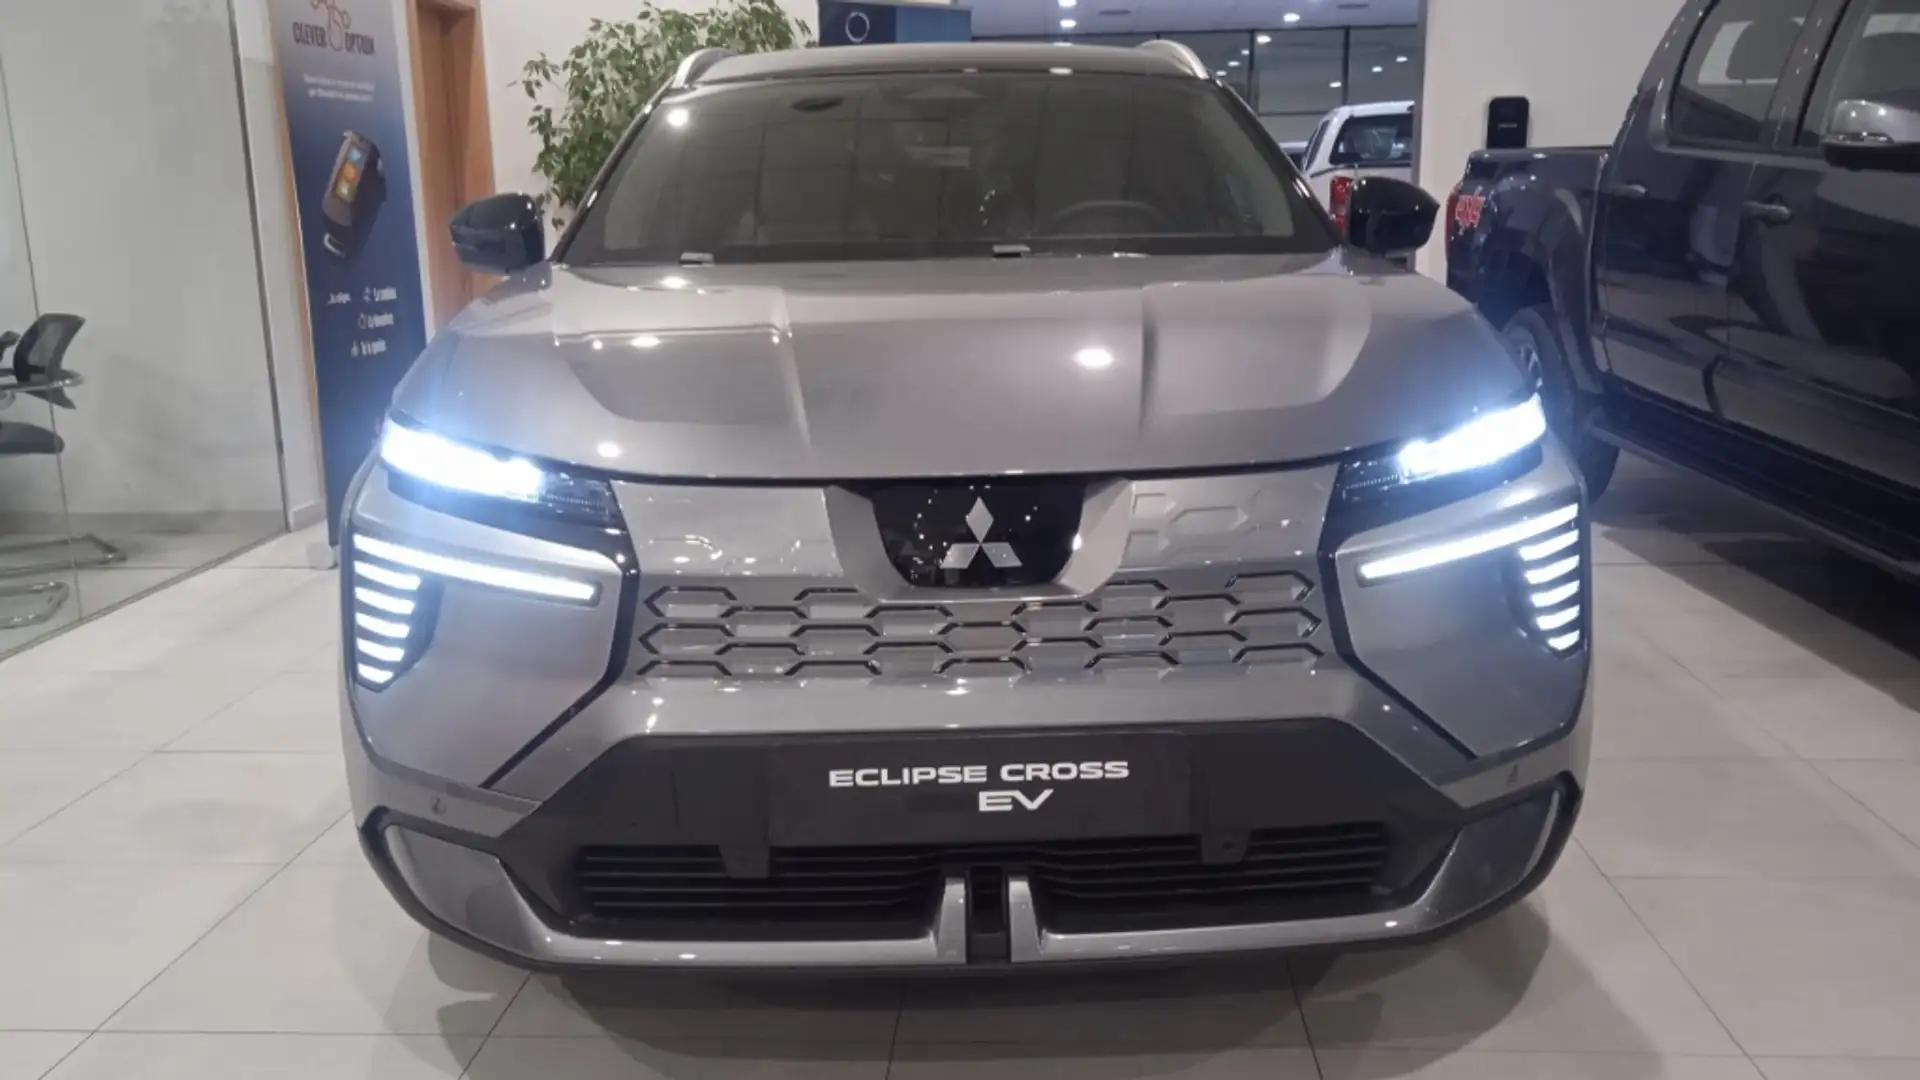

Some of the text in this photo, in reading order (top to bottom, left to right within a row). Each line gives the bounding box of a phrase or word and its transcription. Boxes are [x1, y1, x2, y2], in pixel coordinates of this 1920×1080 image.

[293, 21, 327, 48] CLEVER
[829, 761, 1130, 788] ECLIPSE CROSS
[978, 789, 1054, 812] EV
